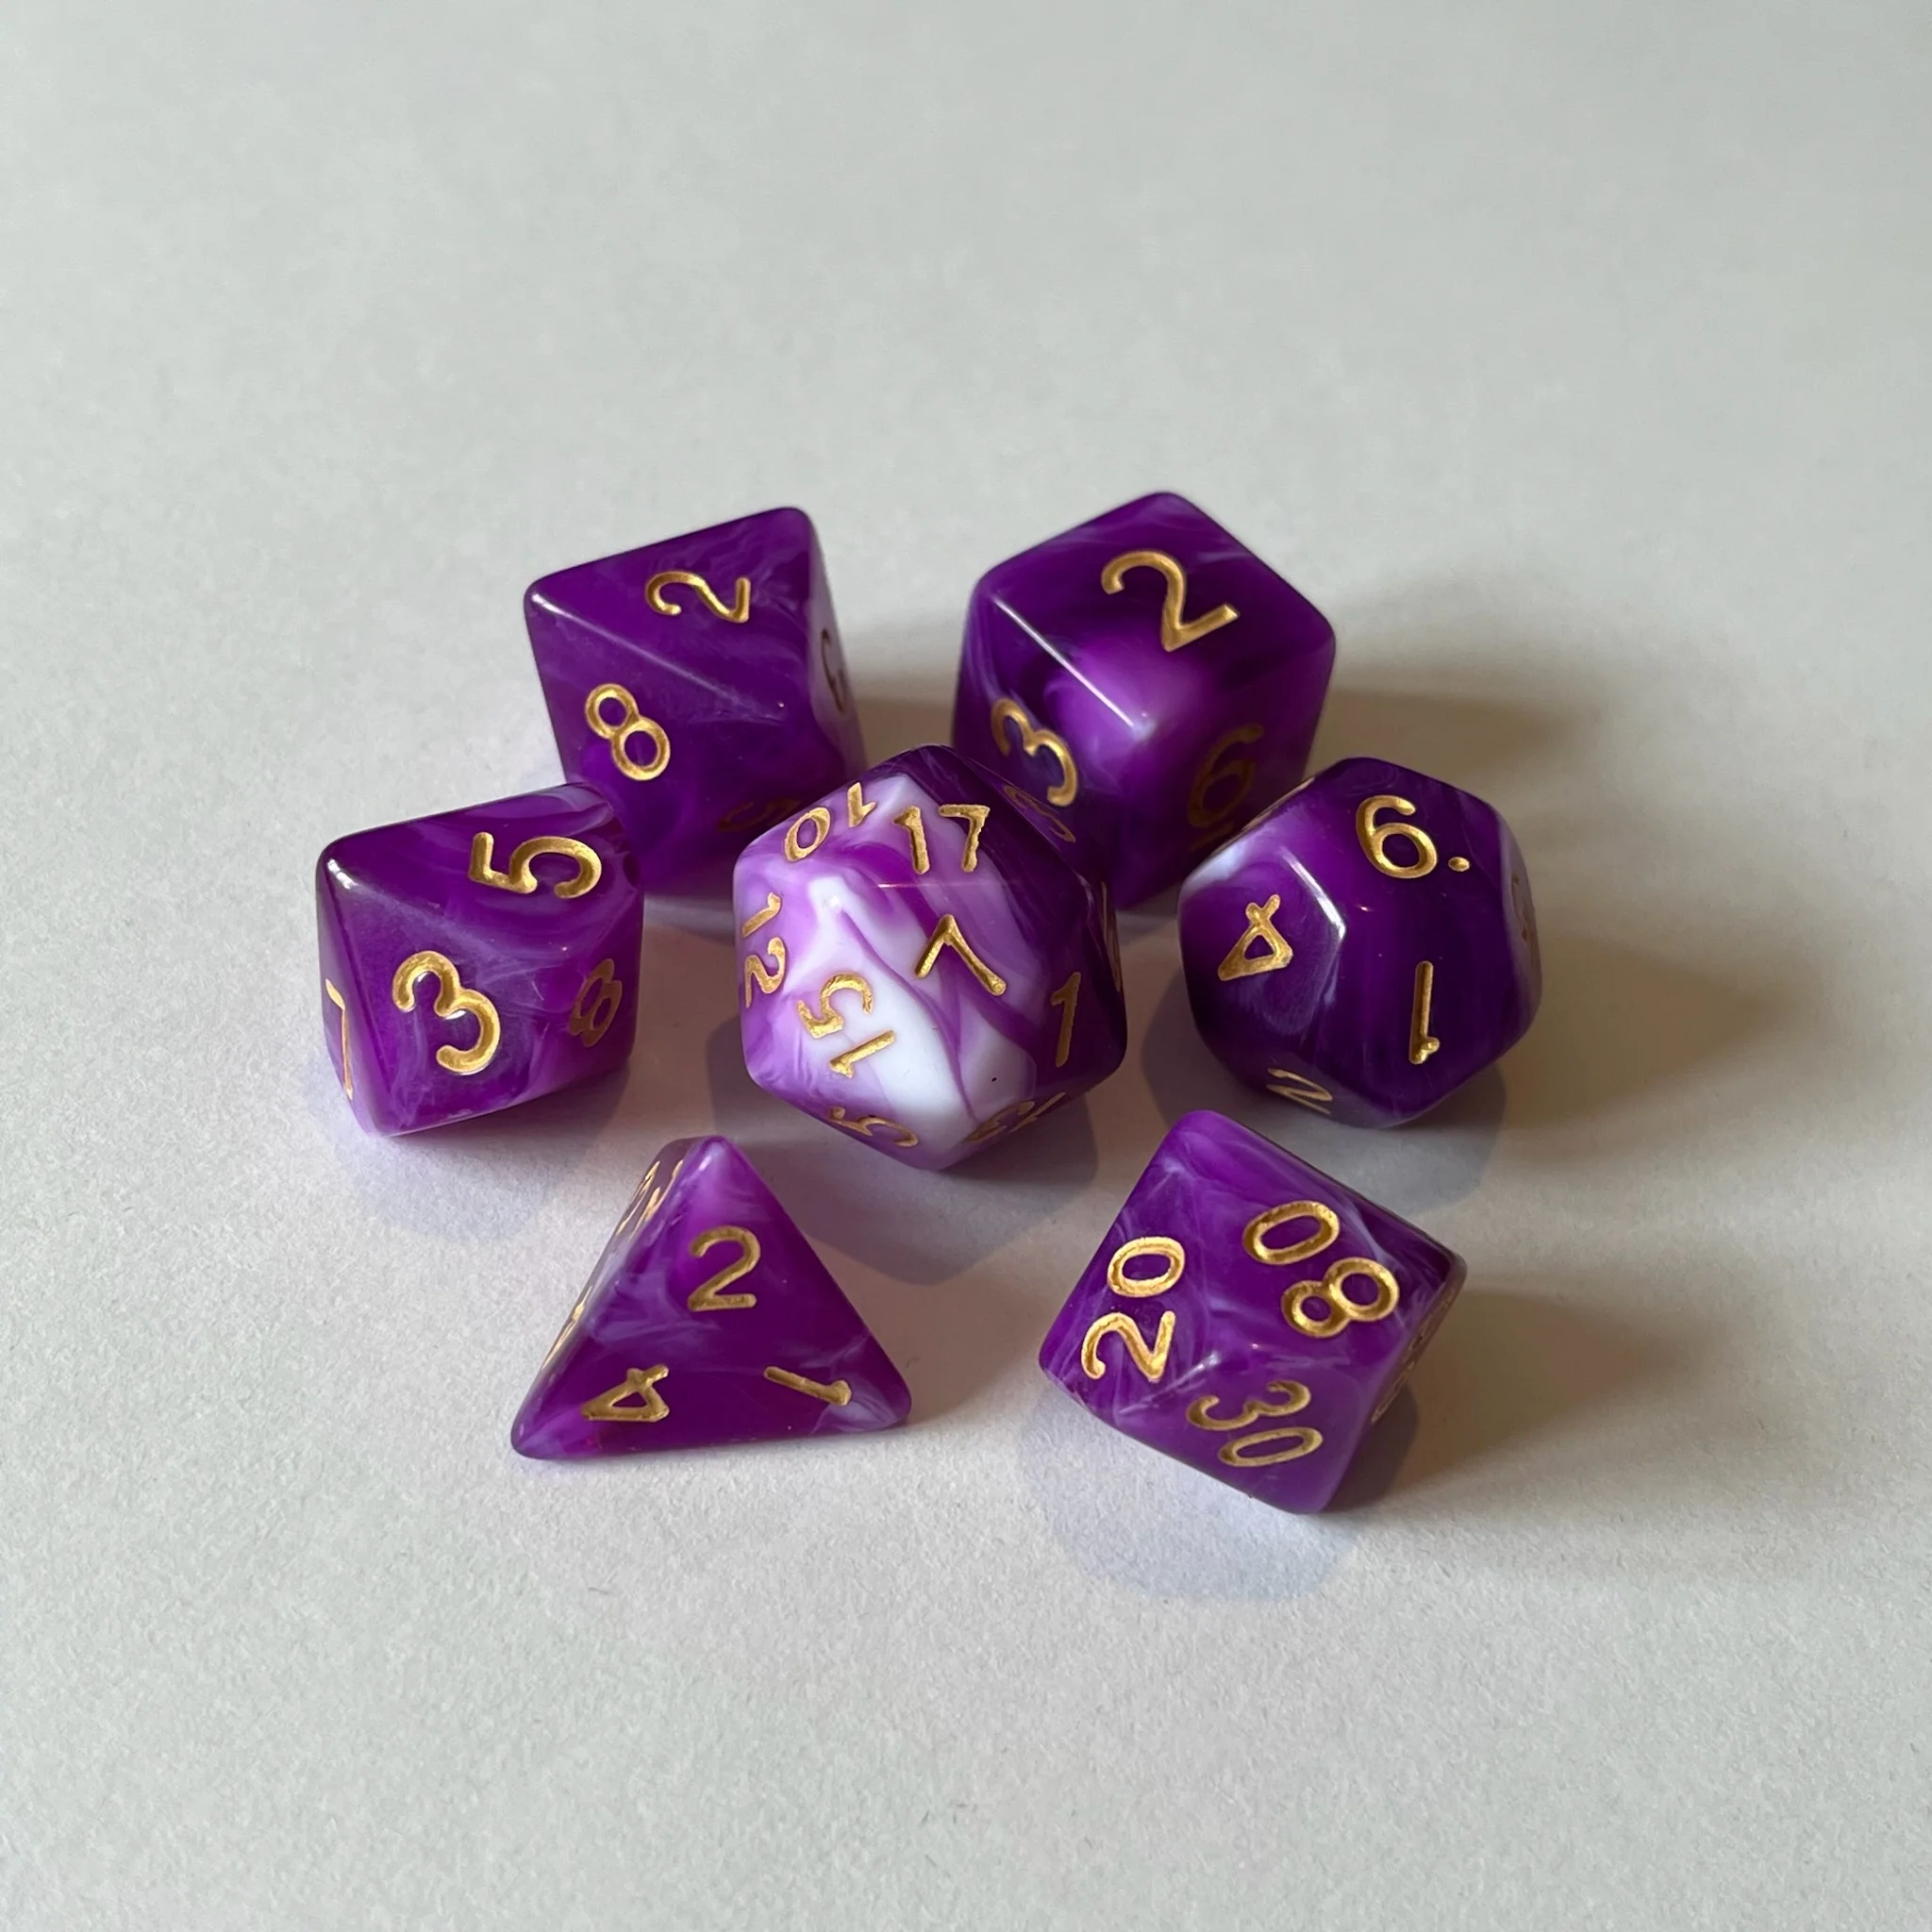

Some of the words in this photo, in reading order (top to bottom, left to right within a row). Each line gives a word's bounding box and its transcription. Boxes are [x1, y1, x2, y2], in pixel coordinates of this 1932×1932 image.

[645, 571, 751, 623] 2
[1101, 550, 1240, 652] 2
[584, 683, 670, 781] 8
[991, 698, 1077, 807] 3
[1186, 723, 1264, 828] 6
[468, 832, 602, 898] 5
[893, 804, 991, 876] 17
[741, 892, 787, 1008] 12
[914, 914, 1007, 996] 7
[1218, 894, 1293, 981] 4
[392, 951, 501, 1075] 3
[570, 958, 623, 1047] 8
[796, 973, 896, 1078] 15
[1050, 972, 1081, 1067] 1
[1409, 960, 1440, 1064] 1
[687, 1225, 761, 1312] 2
[1081, 1236, 1186, 1383] 20
[1242, 1200, 1400, 1339] 80
[581, 1364, 670, 1423] 4
[763, 1365, 852, 1406] 1
[1186, 1380, 1324, 1468] 30
